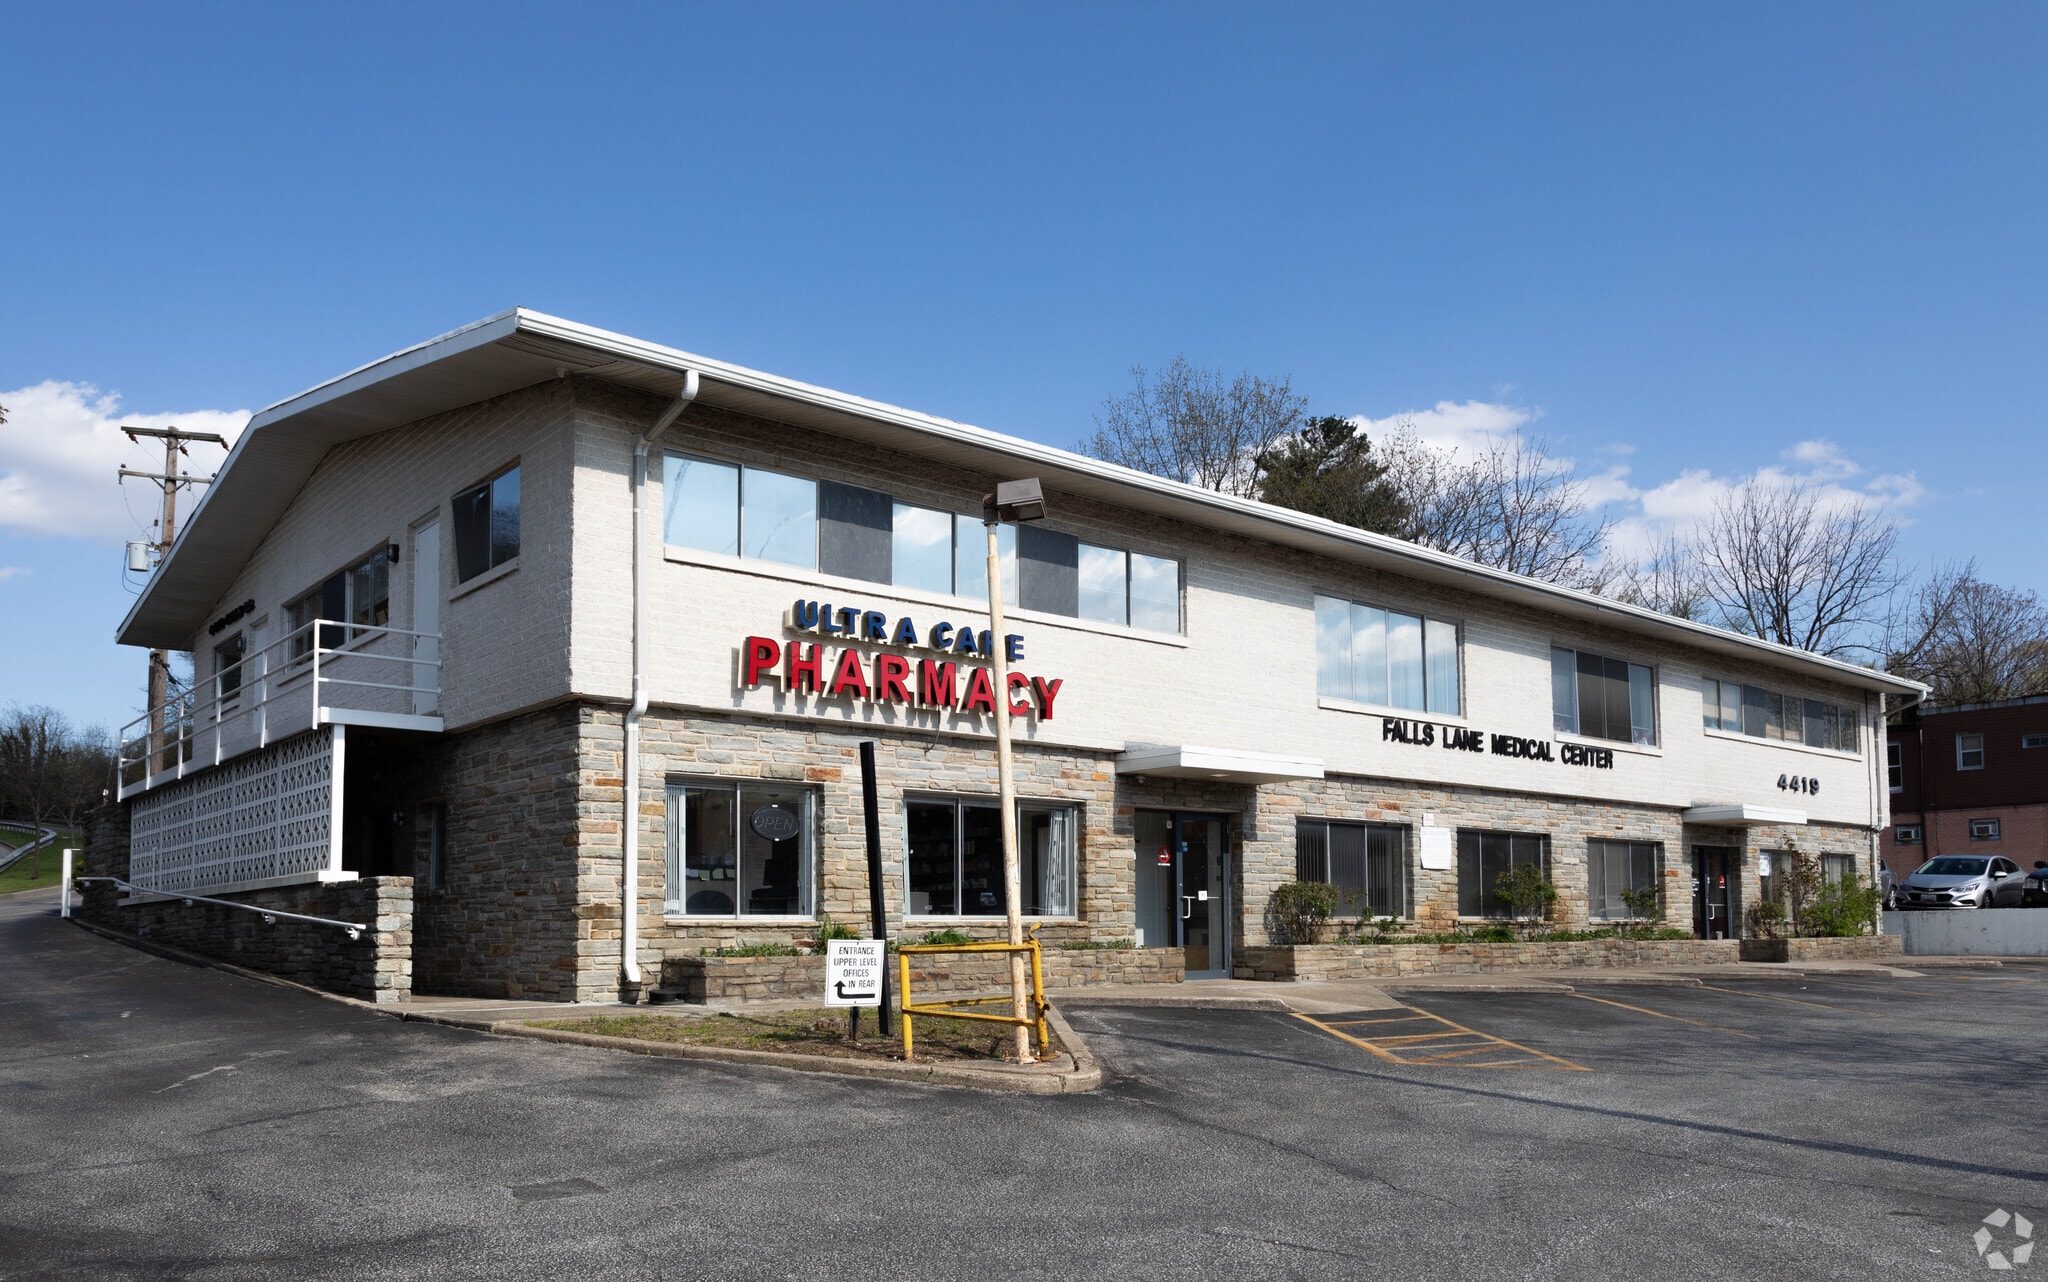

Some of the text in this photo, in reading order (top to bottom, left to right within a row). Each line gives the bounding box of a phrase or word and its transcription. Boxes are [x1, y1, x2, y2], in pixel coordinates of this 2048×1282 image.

[794, 599, 918, 645] ULTRA
[744, 635, 1064, 721] PHARMACY
[1383, 718, 1614, 769] FALLS LANE MEDICAL CENTER
[1777, 773, 1820, 796] 4419
[754, 815, 794, 830] OPEN
[838, 947, 875, 955] ENTRANCE
[833, 958, 877, 966] UPPER LEVEL
[843, 969, 869, 977] OFFICES
[848, 980, 875, 988] IN REAR
